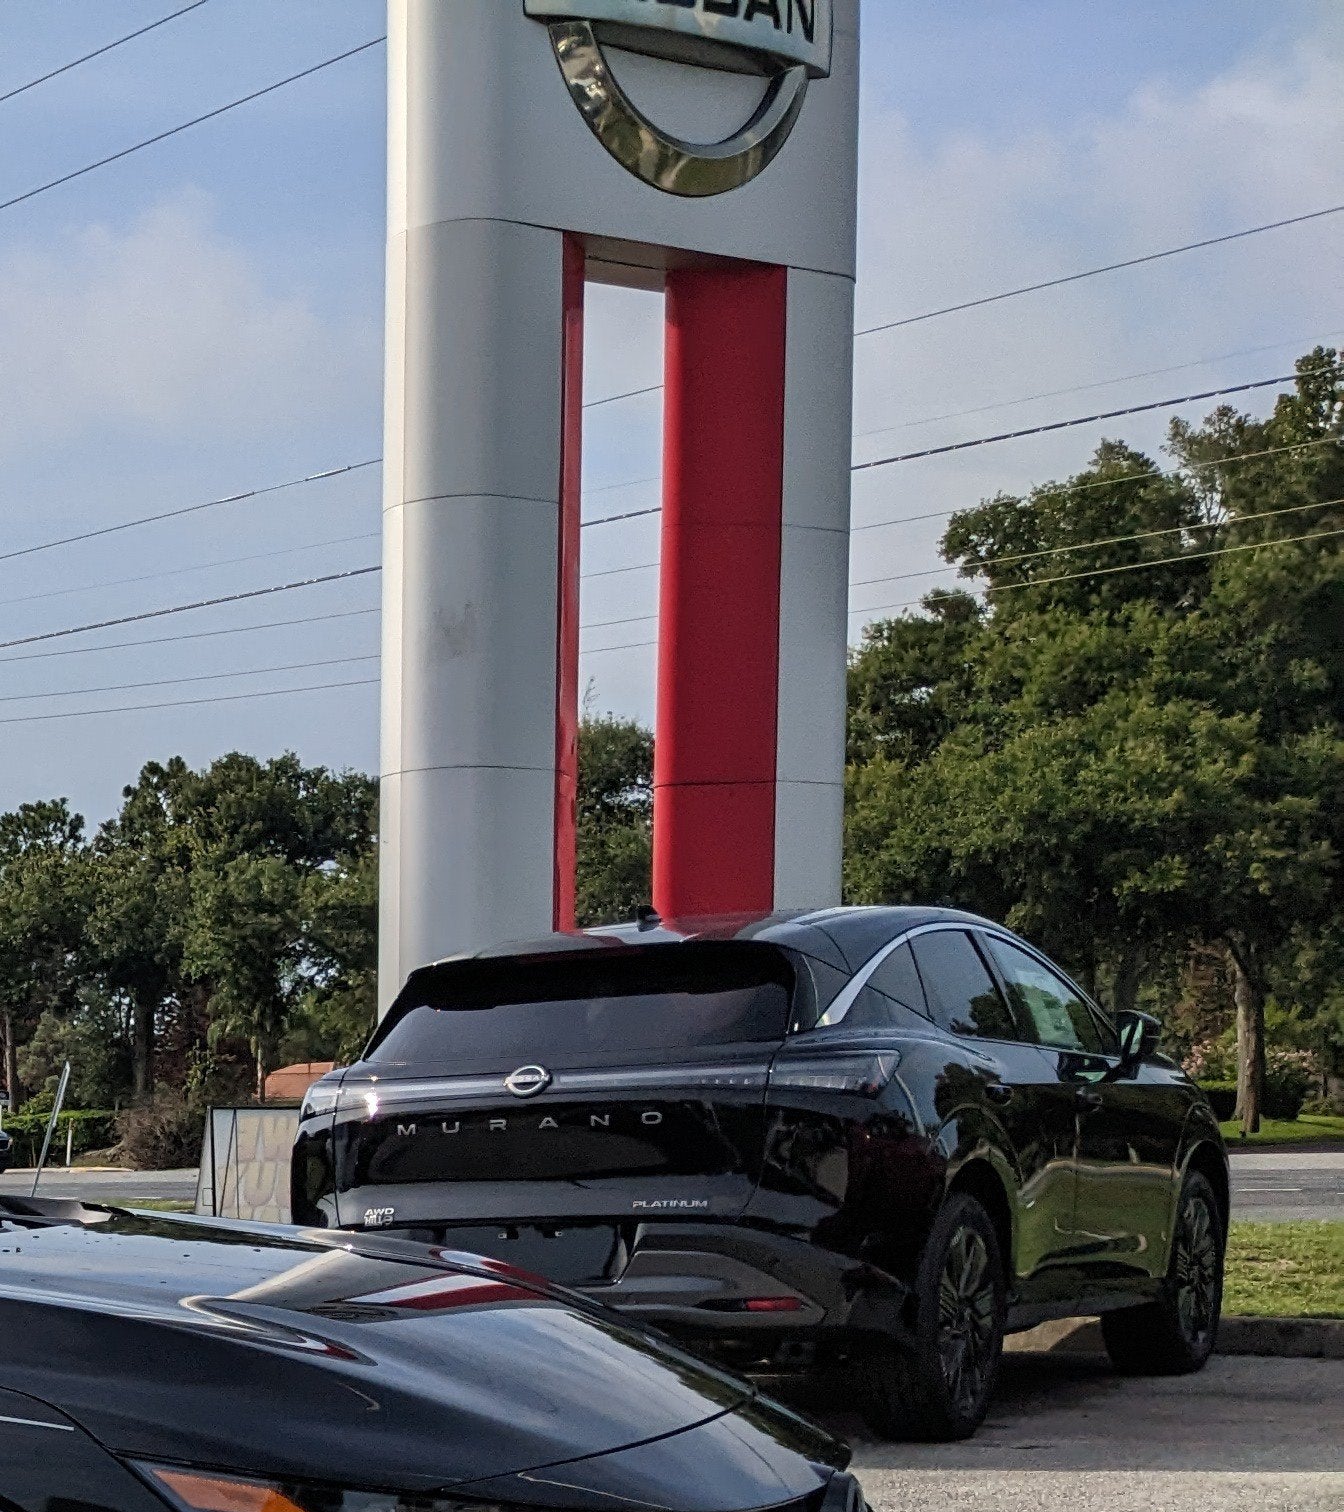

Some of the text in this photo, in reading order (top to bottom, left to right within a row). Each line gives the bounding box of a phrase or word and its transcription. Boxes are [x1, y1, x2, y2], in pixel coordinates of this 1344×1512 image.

[396, 1111, 663, 1136] MURANO
[632, 1199, 708, 1208] PLATINUM
[364, 1207, 395, 1216] AWD
